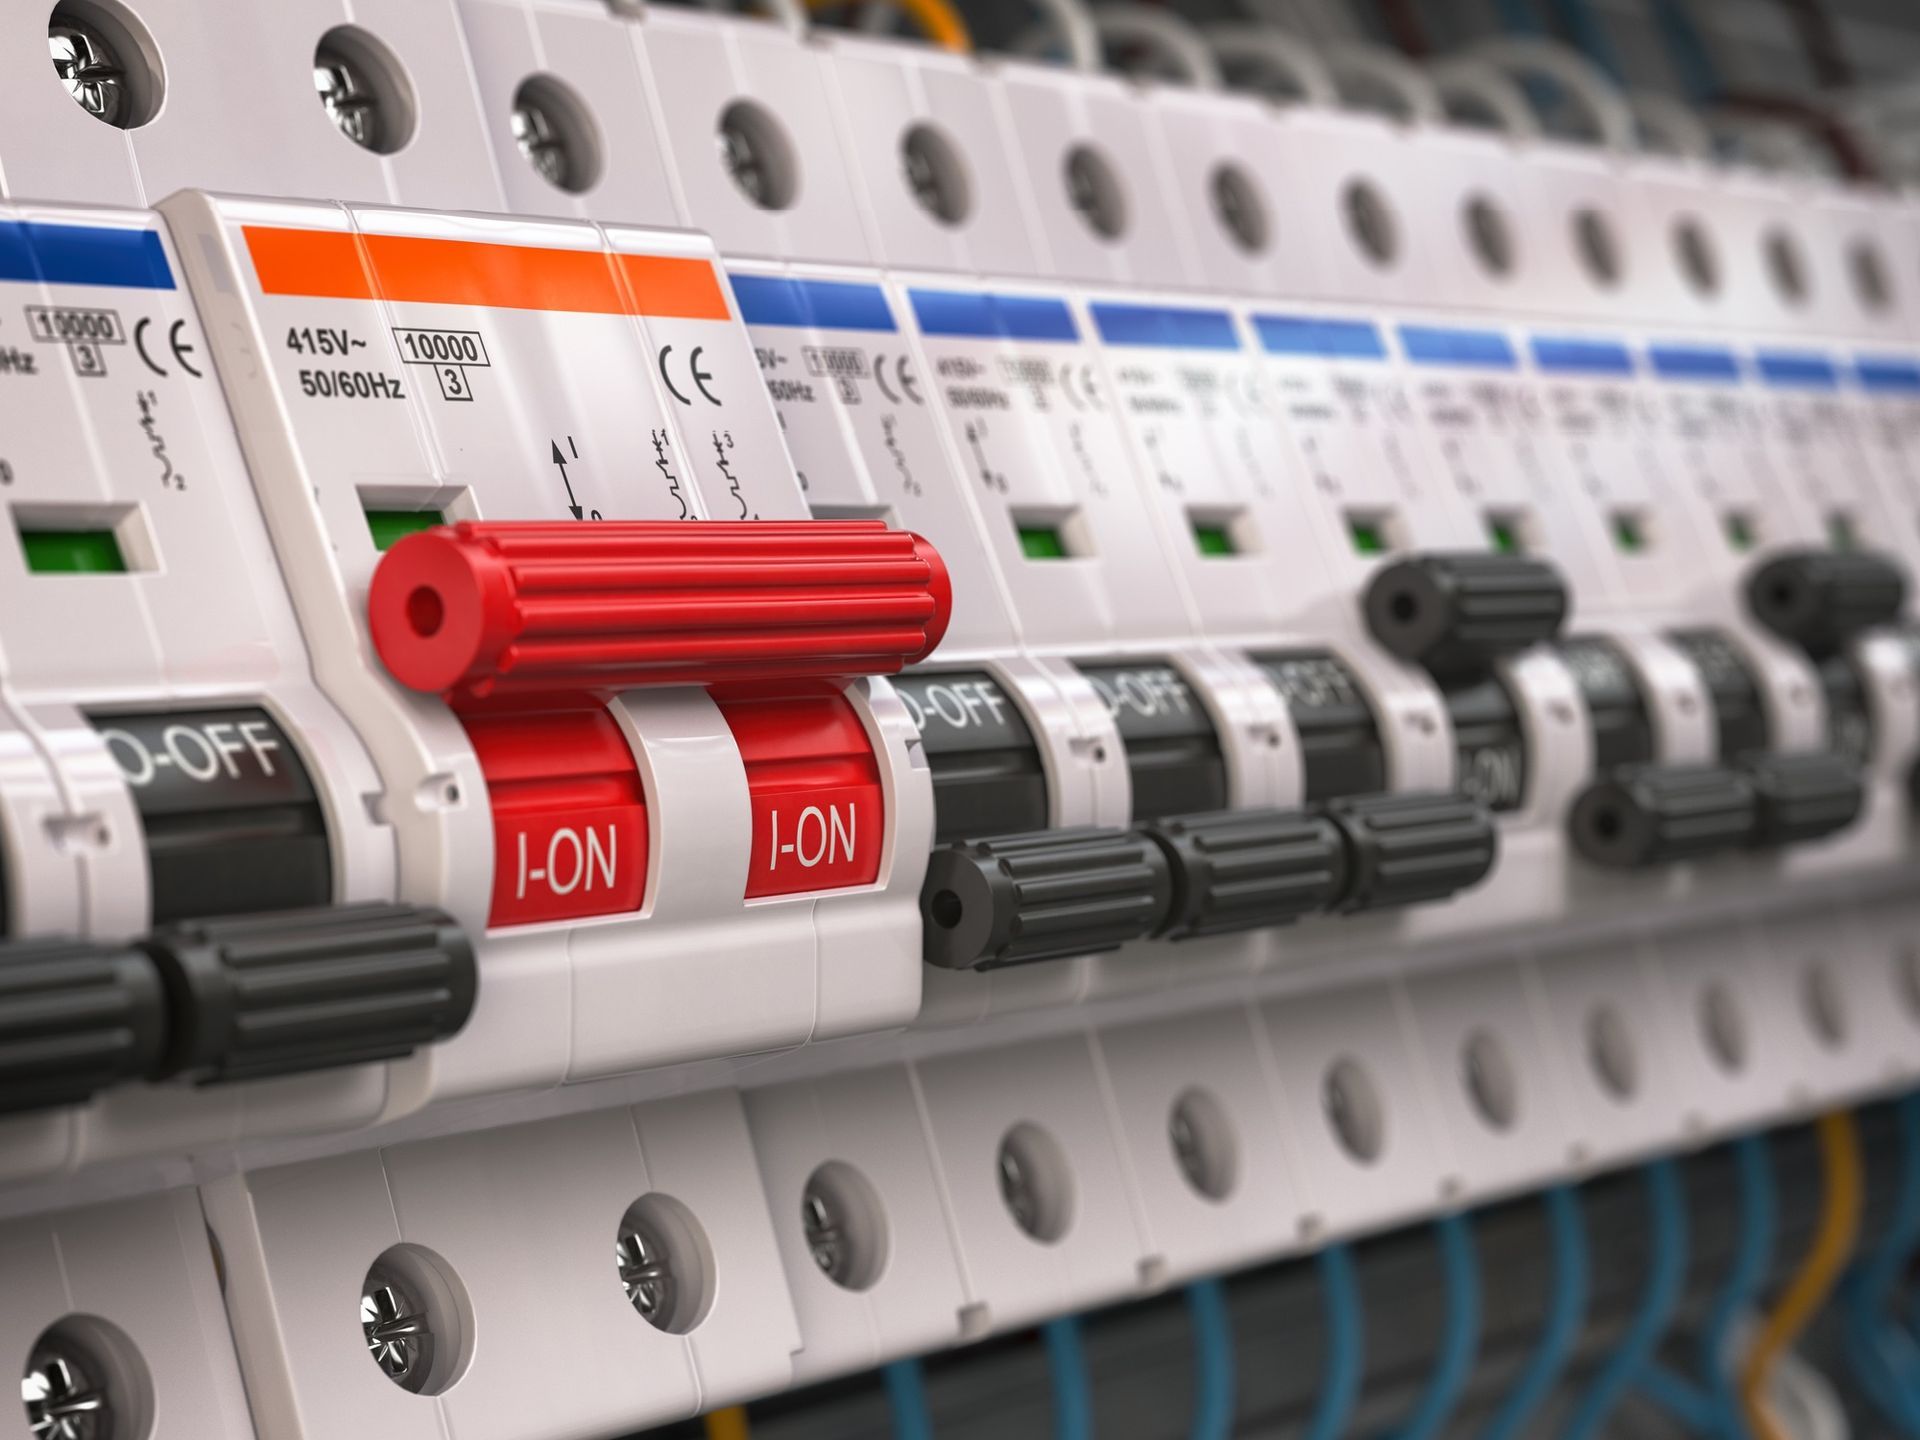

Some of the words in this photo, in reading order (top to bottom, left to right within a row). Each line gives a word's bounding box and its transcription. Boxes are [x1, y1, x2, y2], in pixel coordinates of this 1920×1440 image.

[134, 316, 202, 378] CE
[286, 327, 368, 357] 415V~
[403, 332, 479, 363] 10000
[299, 370, 406, 399] 50/60Hz
[443, 367, 463, 395] 3
[659, 344, 723, 406] CE
[873, 355, 925, 405] CE
[515, 824, 617, 900] I-ON
[769, 803, 856, 871] I-ON
